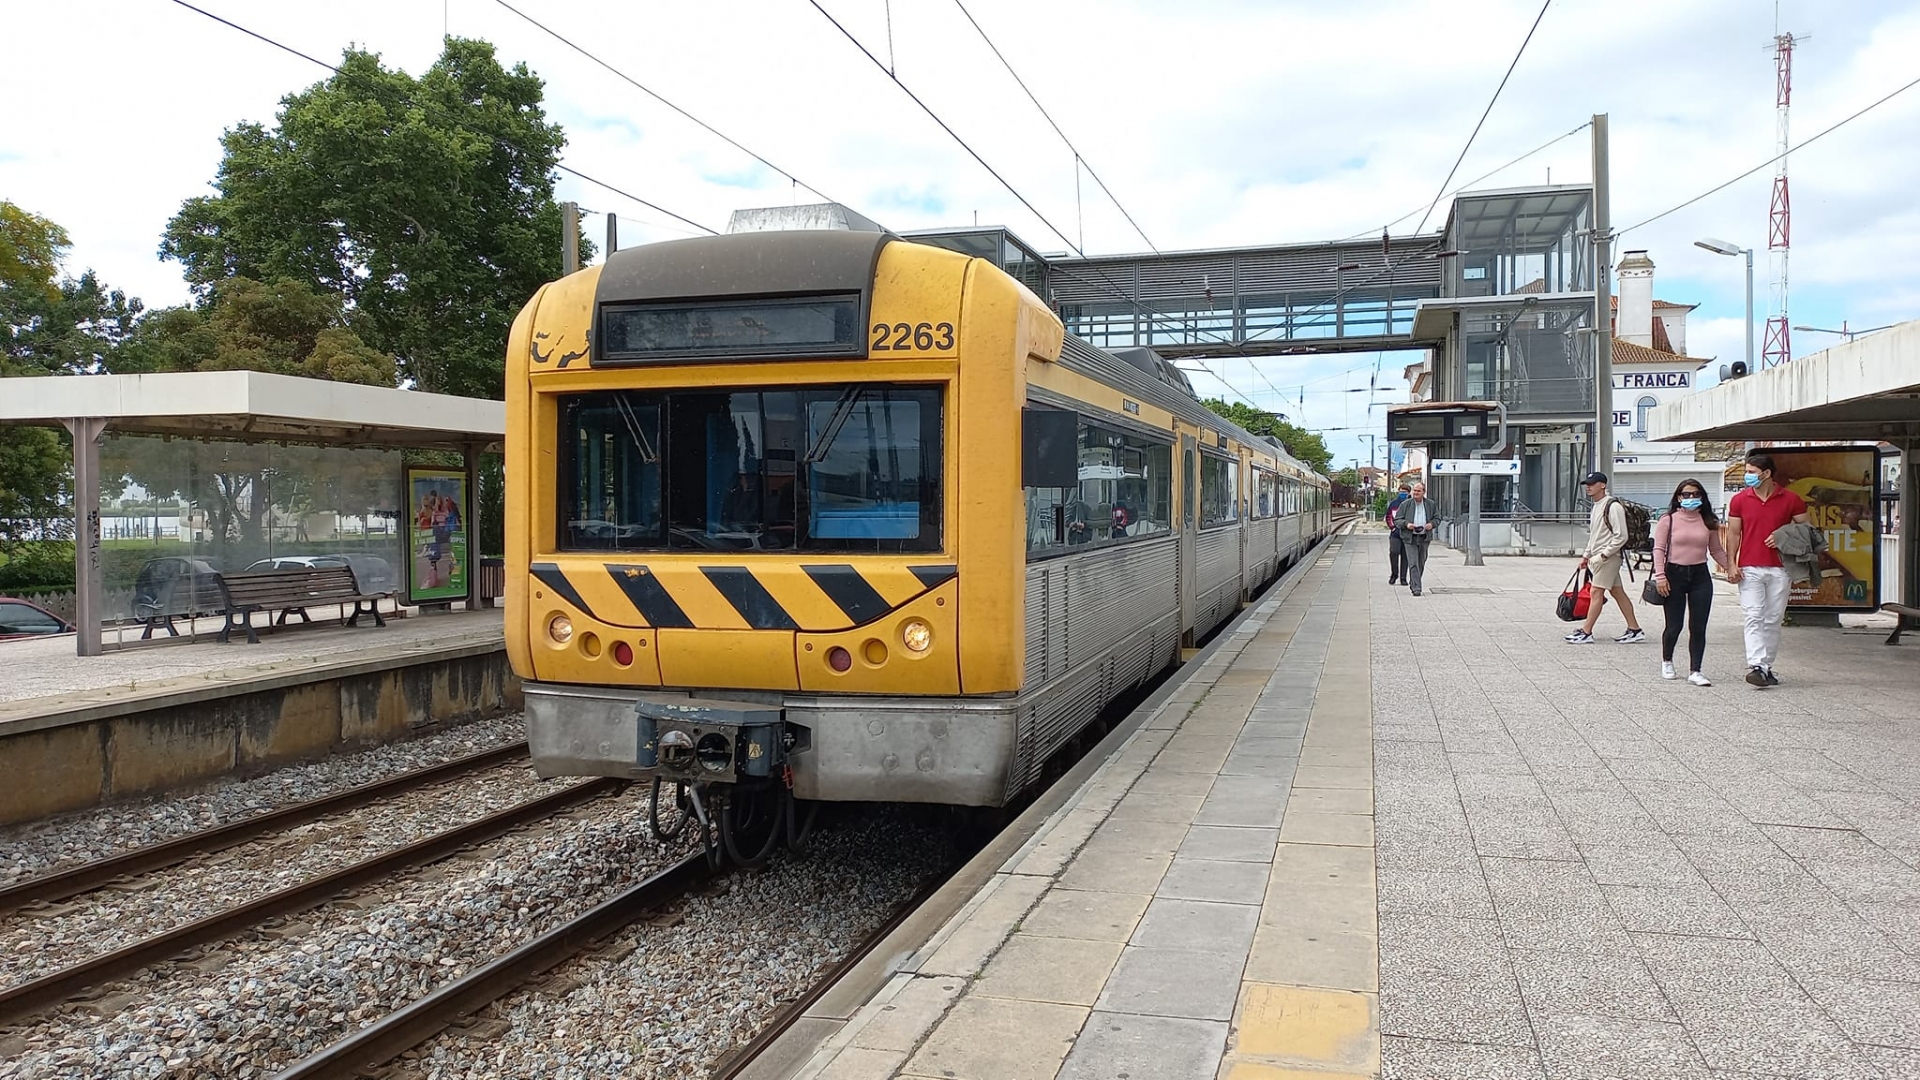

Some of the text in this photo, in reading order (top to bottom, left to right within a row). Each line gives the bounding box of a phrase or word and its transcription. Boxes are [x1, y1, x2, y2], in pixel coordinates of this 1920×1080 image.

[872, 322, 955, 351] 2263
[1623, 373, 1688, 387] FRANCA
[1807, 505, 1842, 527] AIS
[1823, 529, 1857, 551] ITE
